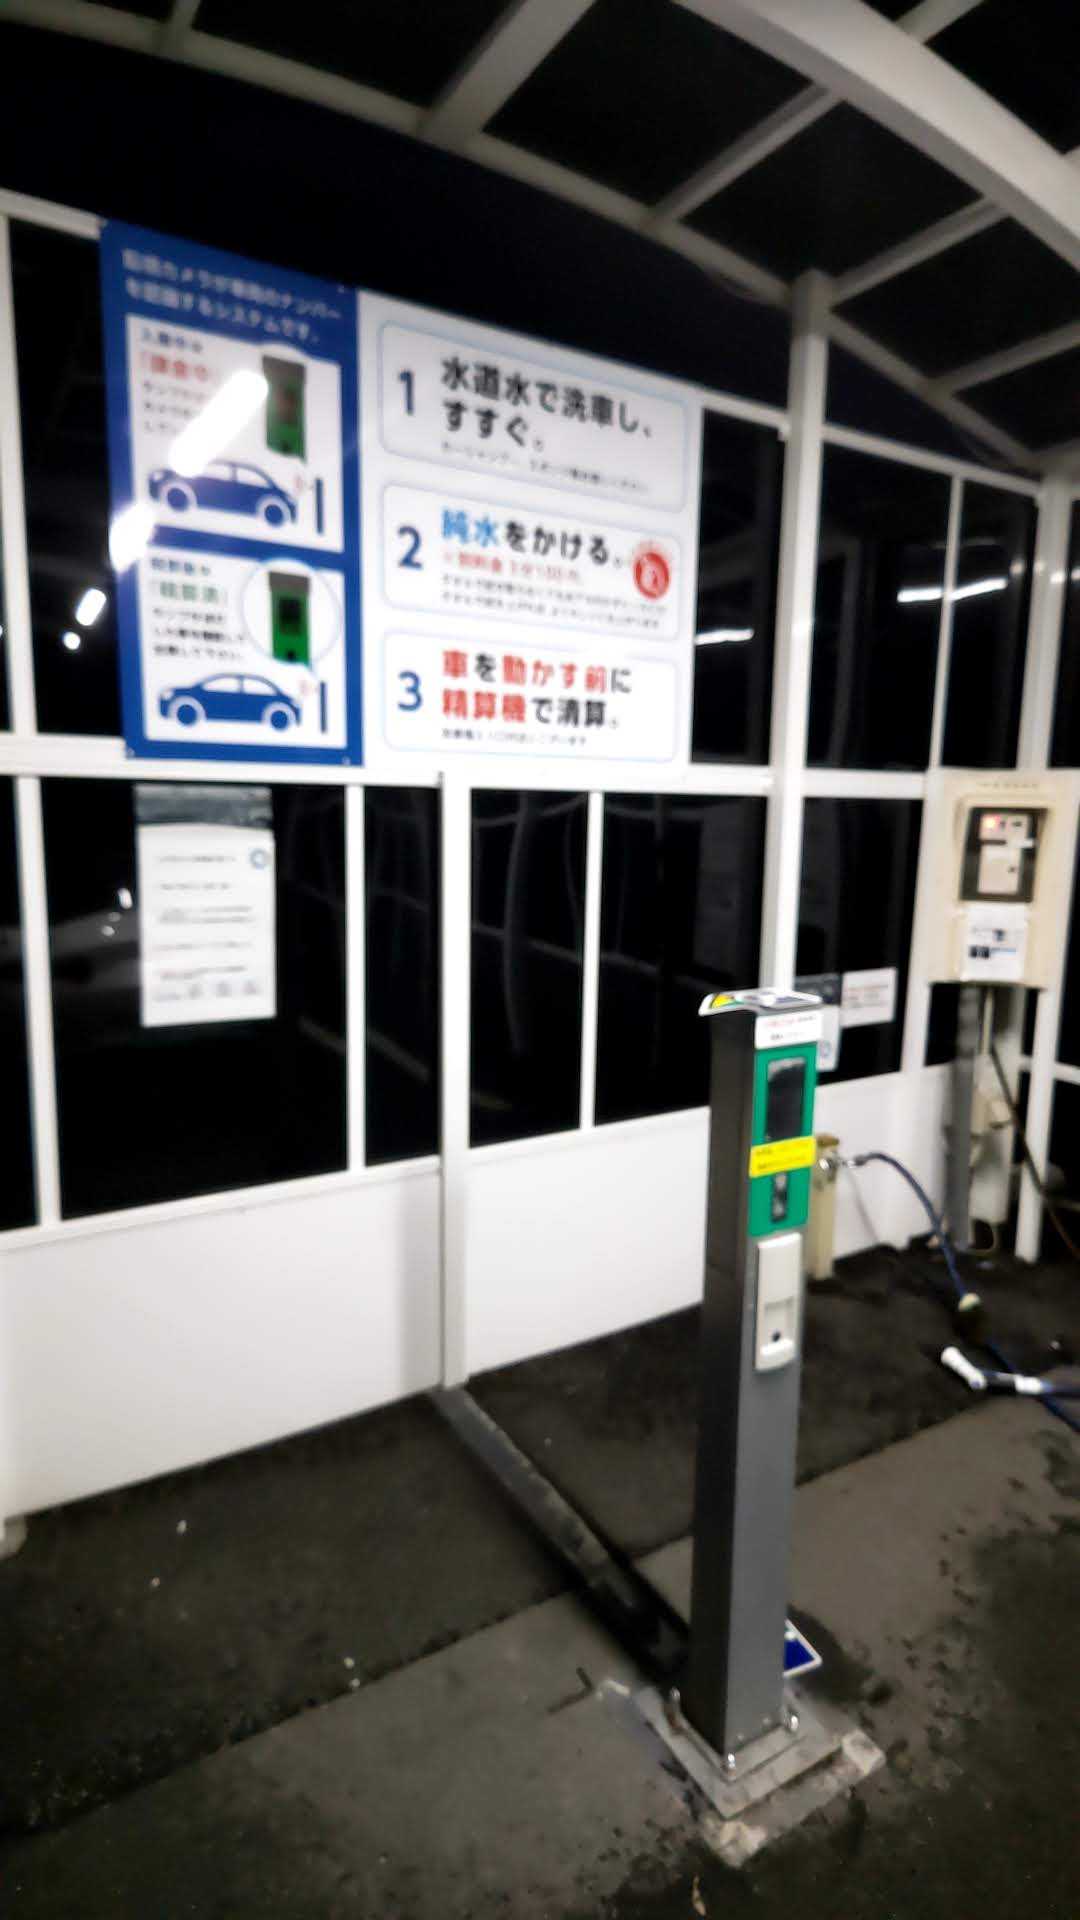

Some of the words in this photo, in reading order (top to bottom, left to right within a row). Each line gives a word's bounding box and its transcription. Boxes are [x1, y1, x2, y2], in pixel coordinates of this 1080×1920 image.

[397, 368, 415, 417] 1
[440, 355, 653, 439] 水道水で洗車し、
[442, 398, 545, 452] すすぐ。
[397, 526, 423, 571] 2
[440, 506, 625, 568] 純水をかける。
[397, 671, 423, 713] 3
[441, 649, 633, 695] 車を動かす前に
